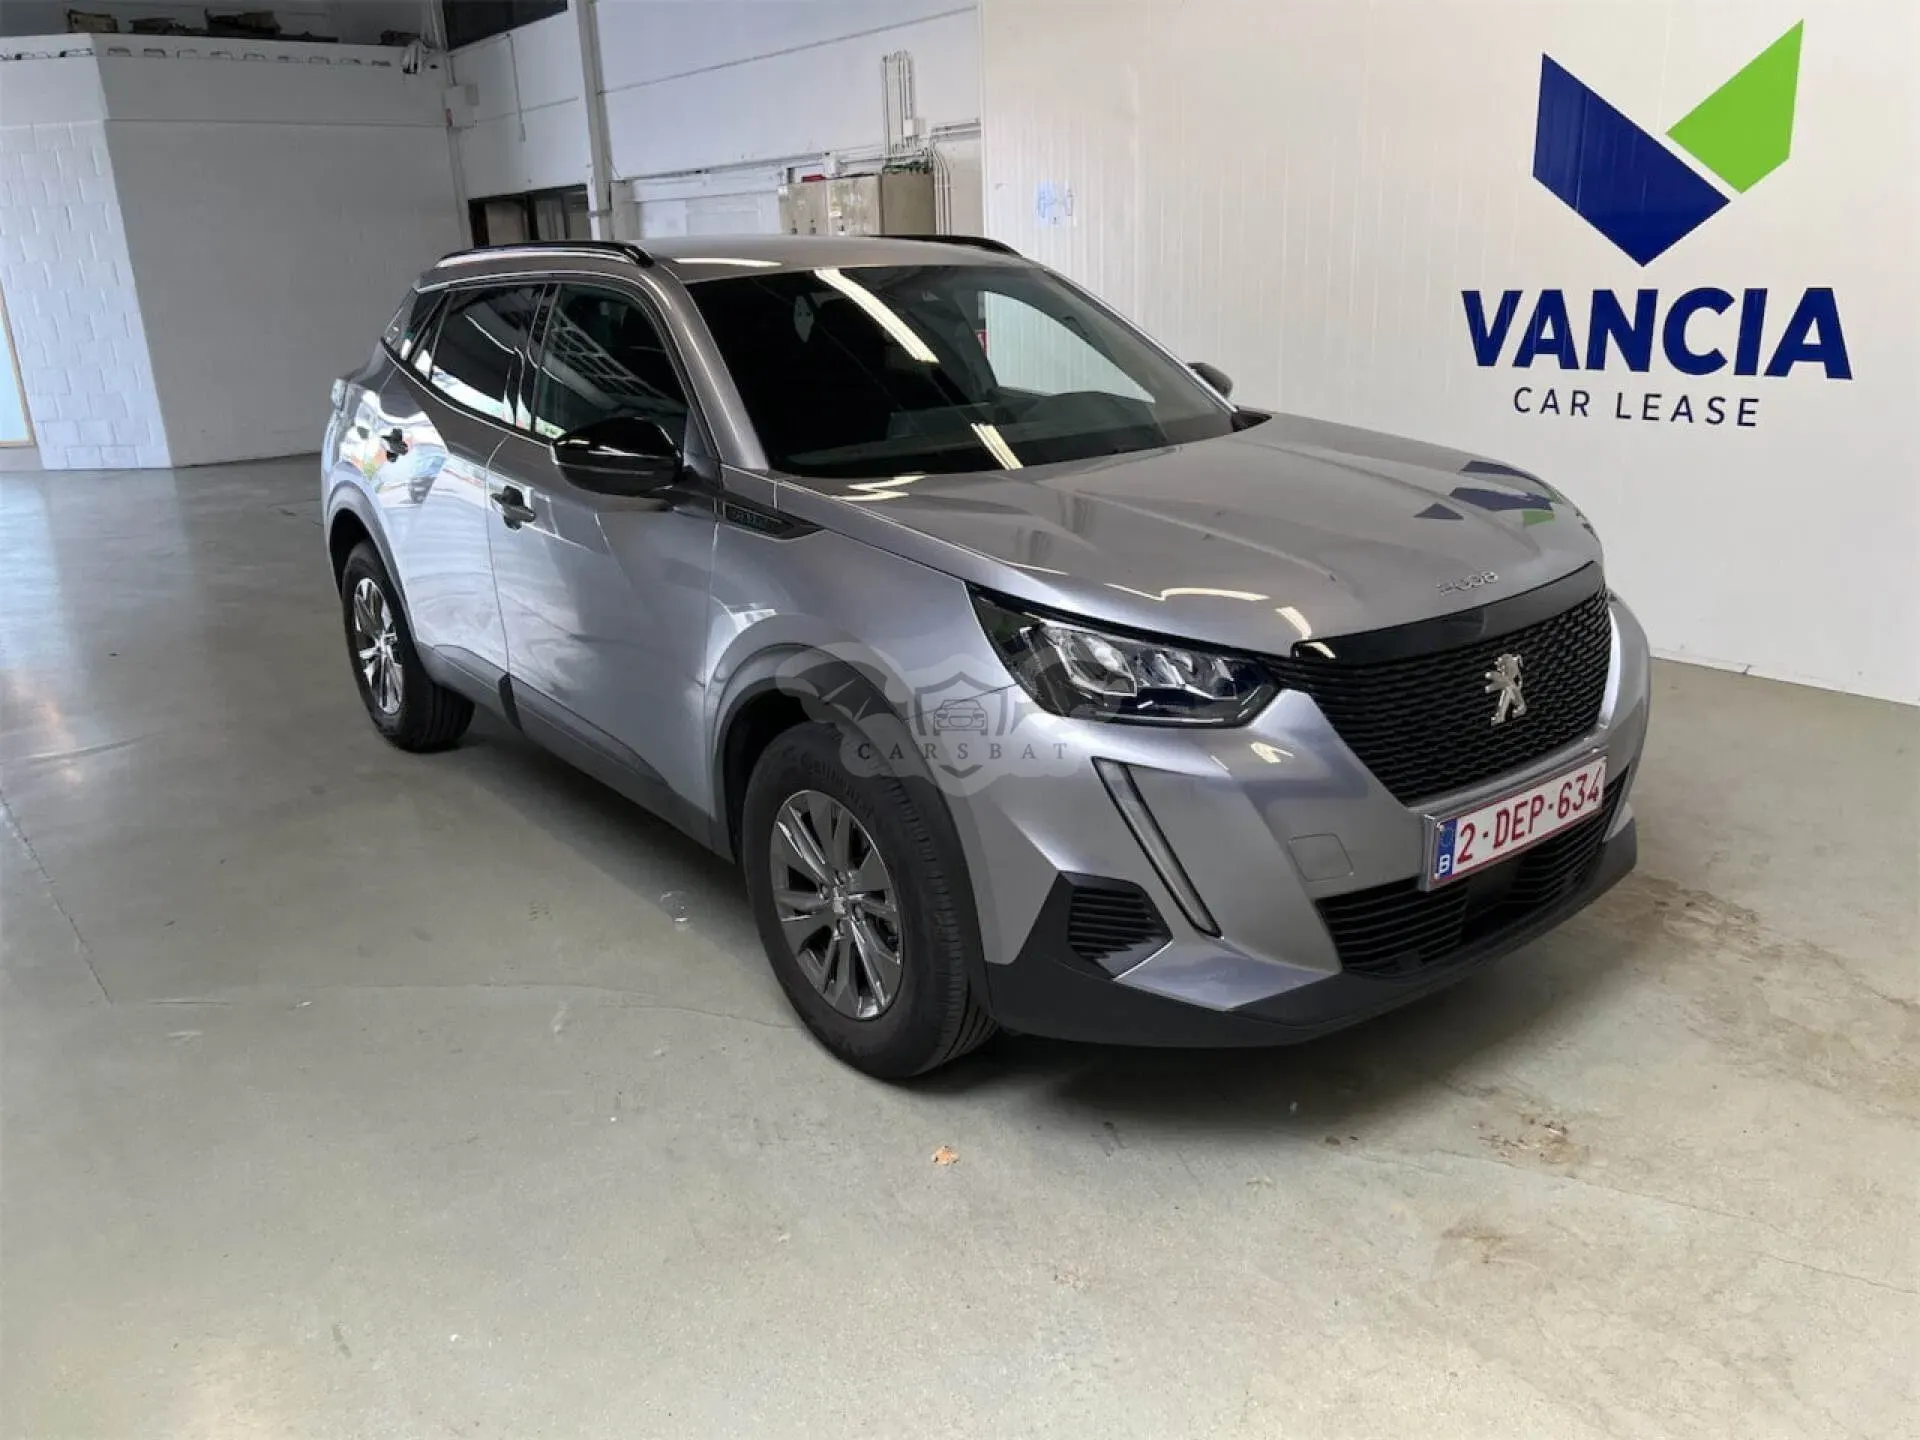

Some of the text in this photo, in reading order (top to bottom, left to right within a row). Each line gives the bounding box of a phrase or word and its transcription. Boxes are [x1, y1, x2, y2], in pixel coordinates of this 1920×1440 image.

[1460, 287, 1853, 380] VANCIA
[1513, 386, 1759, 427] CAR LEASE
[1457, 765, 1603, 865] 2-DEP-634
[1439, 854, 1451, 874] B
